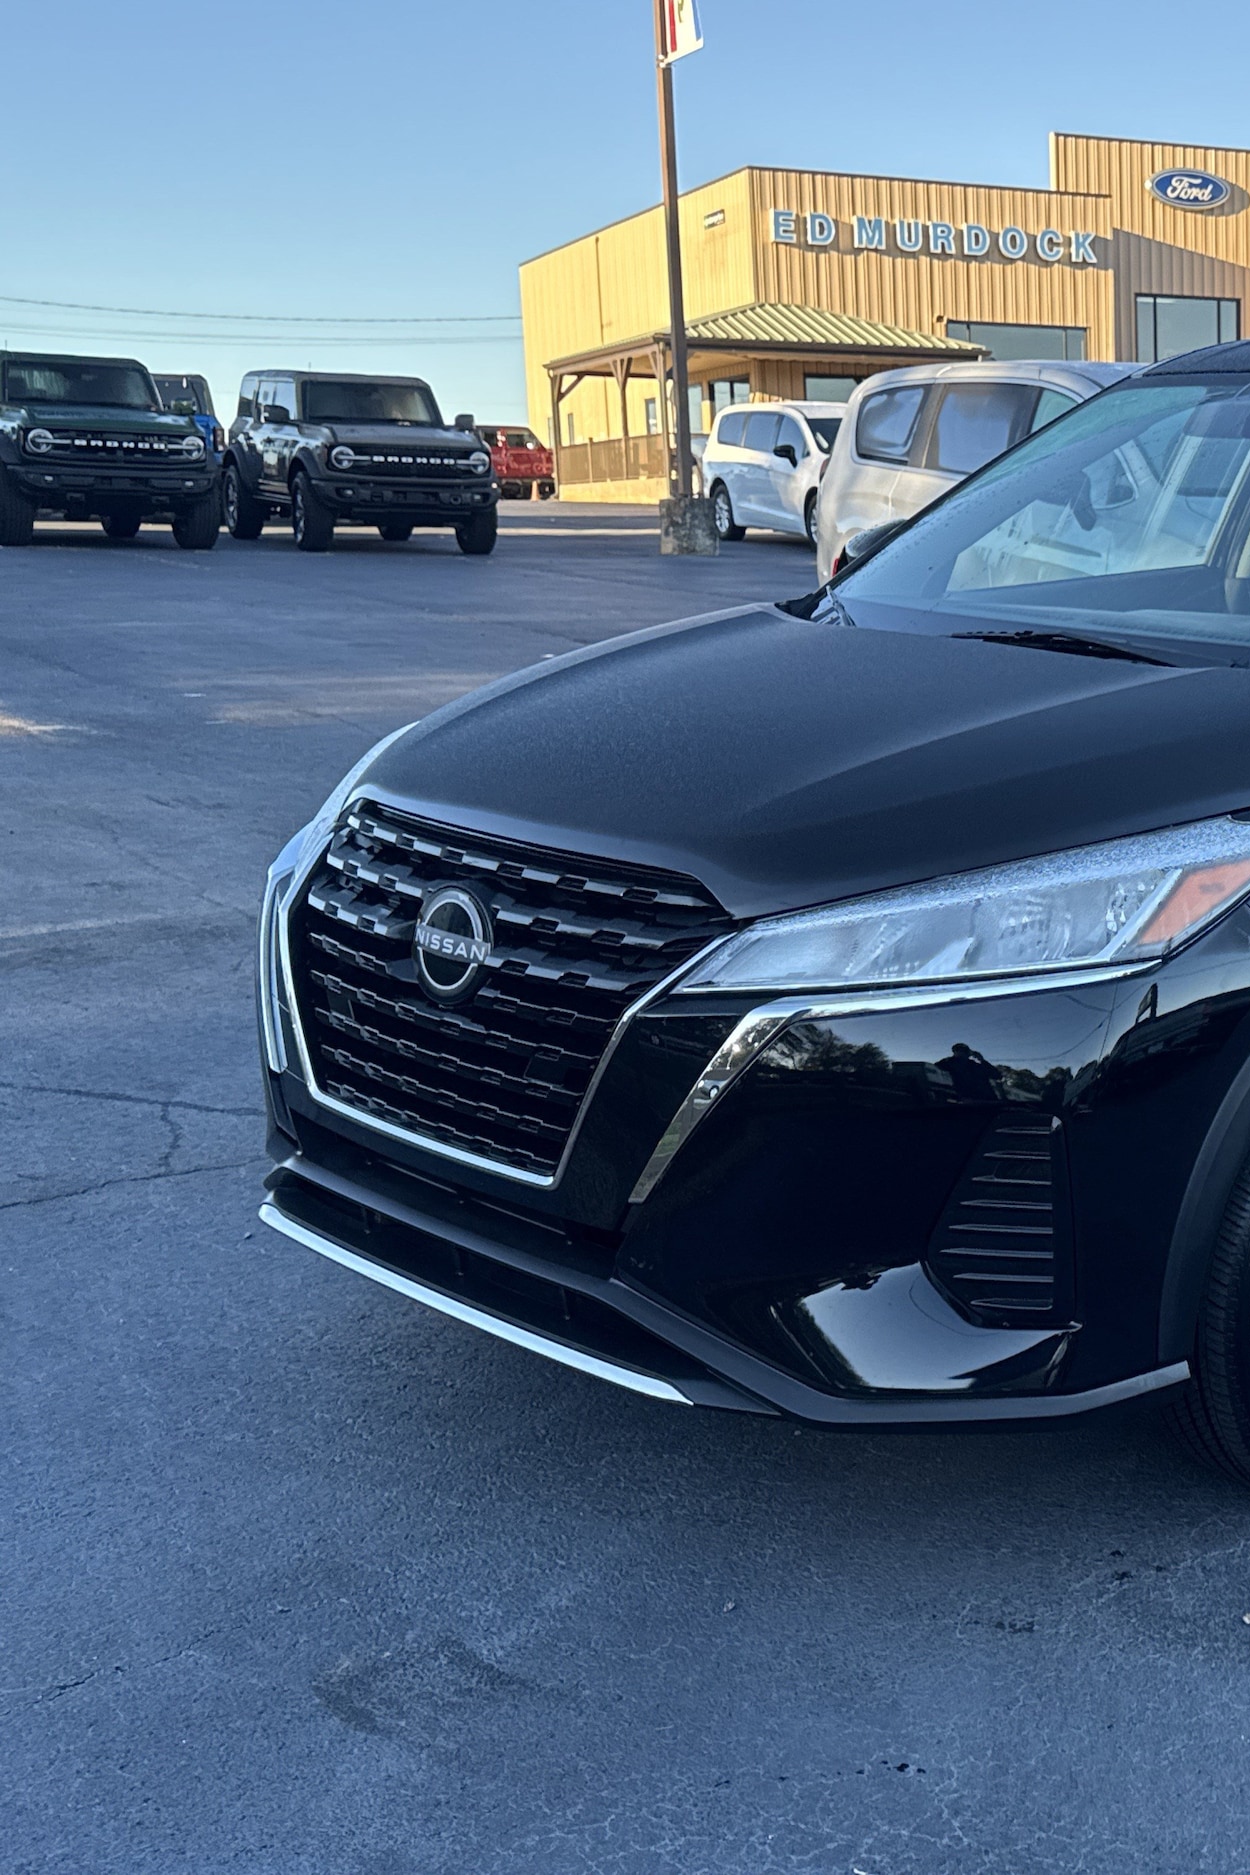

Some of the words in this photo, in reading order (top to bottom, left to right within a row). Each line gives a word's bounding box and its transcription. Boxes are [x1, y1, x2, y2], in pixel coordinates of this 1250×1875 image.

[1166, 175, 1214, 202] Ford
[770, 208, 836, 246] ED
[852, 214, 1098, 264] MURDOCK
[415, 928, 485, 961] NISSAN
